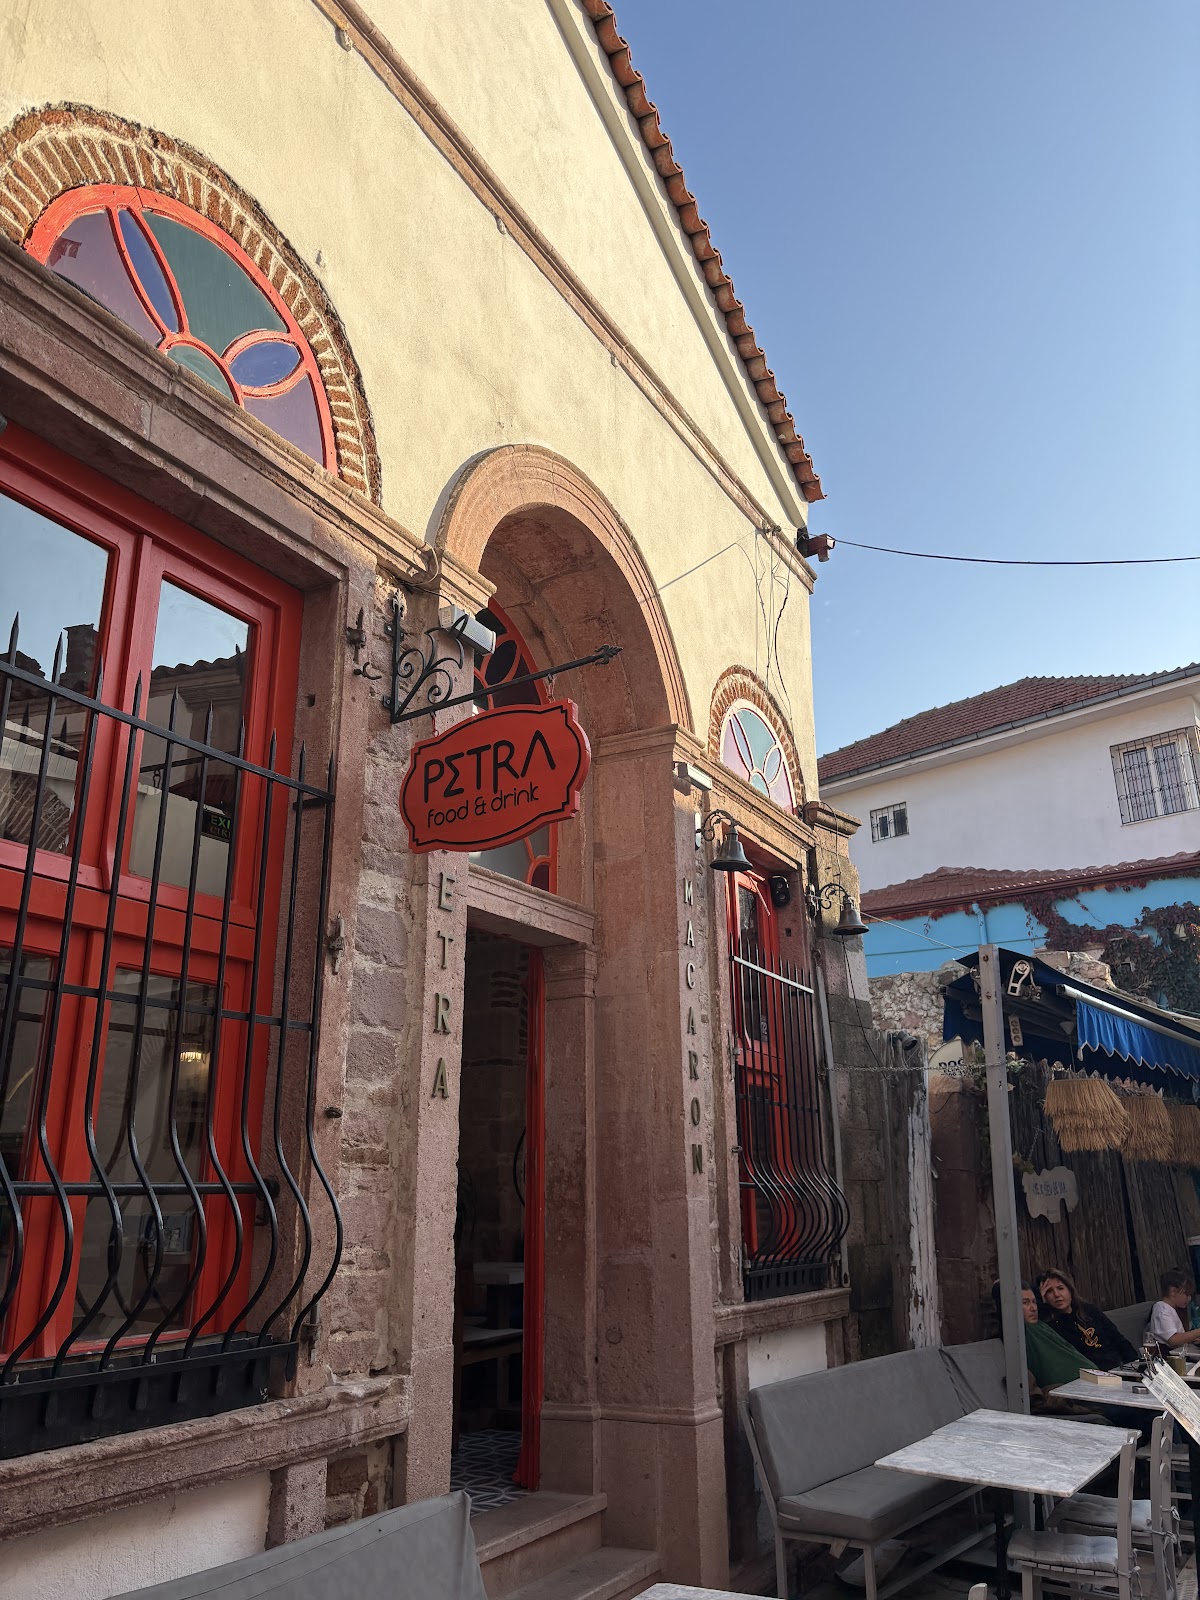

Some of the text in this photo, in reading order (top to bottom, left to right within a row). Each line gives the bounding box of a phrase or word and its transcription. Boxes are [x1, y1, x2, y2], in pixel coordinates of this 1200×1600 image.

[210, 814, 231, 830] EXI
[427, 782, 539, 828] food & drink
[431, 870, 456, 1099] ETRA
[682, 877, 703, 1176] MACARON
